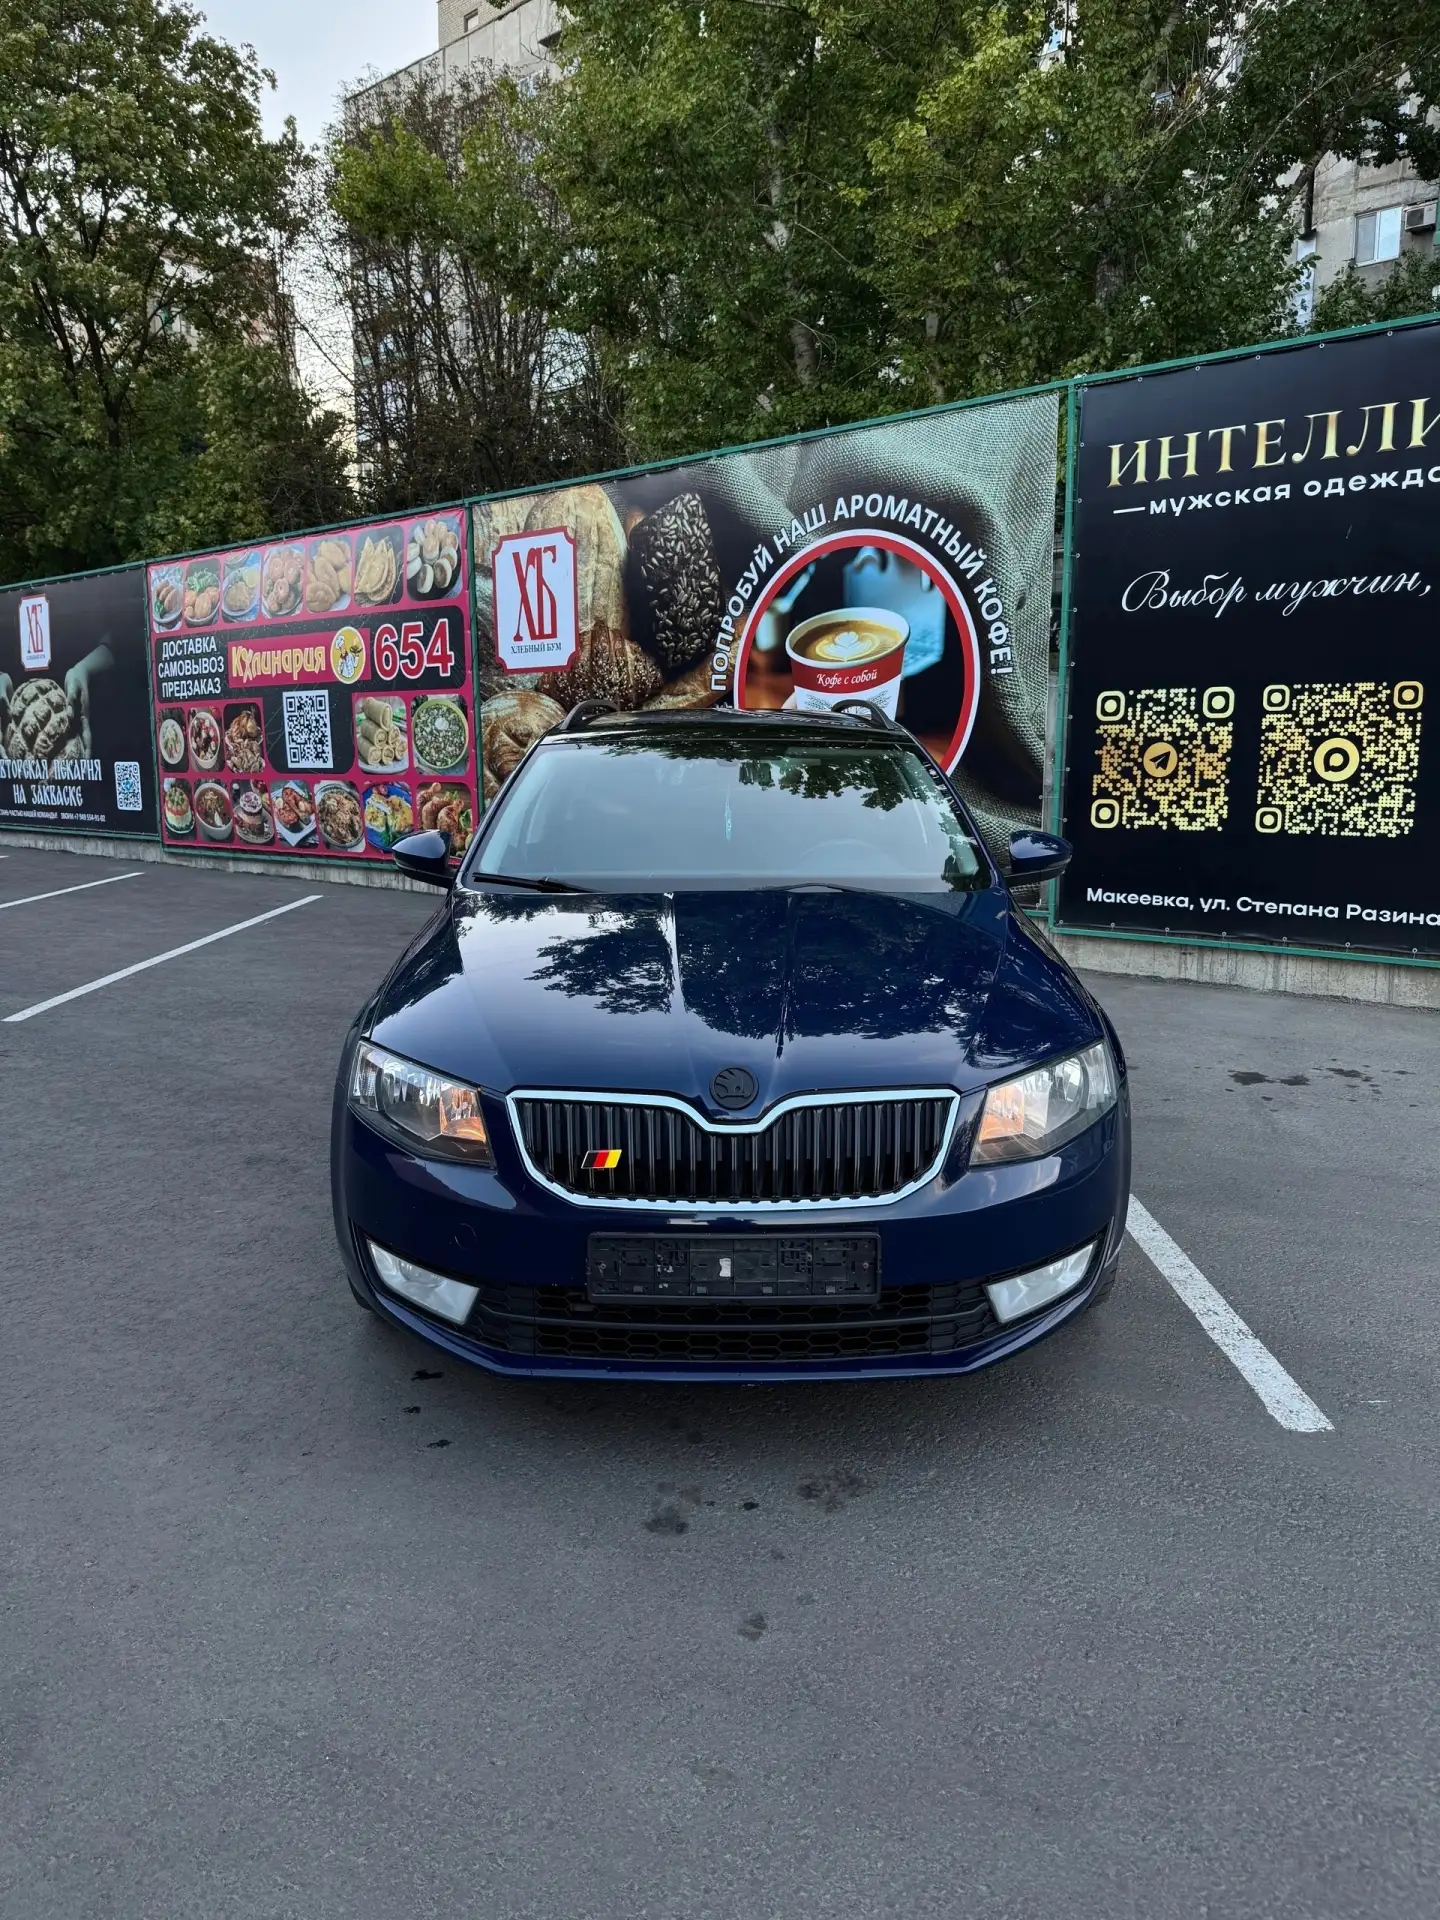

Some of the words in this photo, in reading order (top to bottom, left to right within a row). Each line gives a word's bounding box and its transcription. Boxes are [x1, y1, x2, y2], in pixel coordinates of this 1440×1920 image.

[1149, 483, 1291, 517] мужская
[710, 543, 773, 691] ПОПРОБУЙ
[774, 505, 827, 554] НАШ
[833, 493, 988, 580] АРОМАТНЫЙ
[973, 577, 1014, 676] КОФЕ!
[1121, 568, 1248, 619] Выбор
[1255, 570, 1433, 618] мужчин,
[162, 636, 217, 661] ДОСТАВКА
[374, 618, 455, 681] 654
[510, 642, 546, 655] ХЛЕБНЫЙ
[546, 642, 562, 652] БУМ
[158, 656, 225, 679] САМОВЫВОЗ
[816, 674, 842, 689] Кофе
[844, 676, 849, 685] с
[851, 668, 878, 684] собой
[162, 677, 222, 700] ПРЕДЗАКАЗ
[53, 759, 102, 781] ПЕКАРНЯ
[12, 784, 27, 804] НА
[30, 784, 84, 807] ЗАКВАСКЕ
[1086, 887, 1194, 911] Макеевка,
[1200, 897, 1230, 912] ул.
[1236, 896, 1339, 918] Степана
[1345, 904, 1440, 926] Разина
